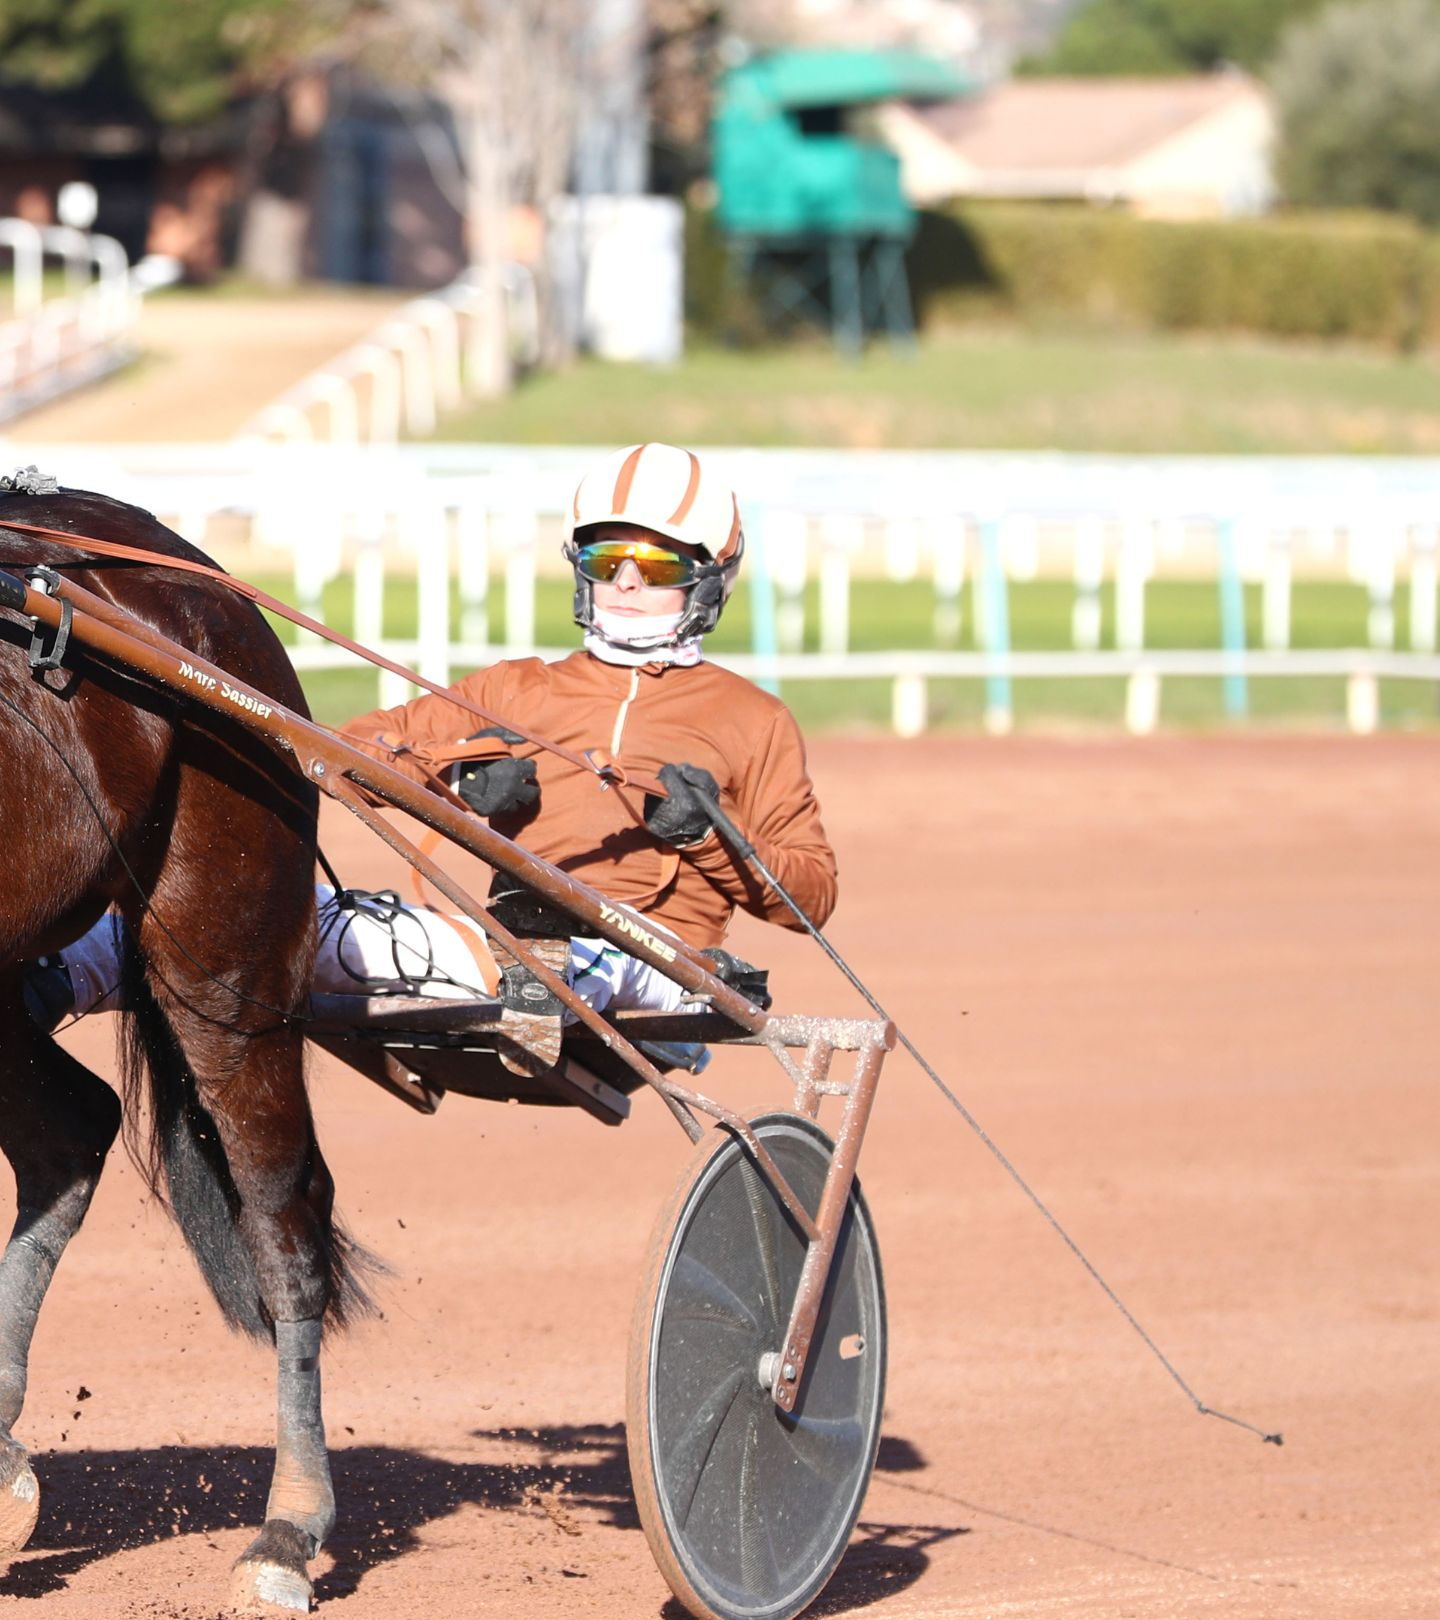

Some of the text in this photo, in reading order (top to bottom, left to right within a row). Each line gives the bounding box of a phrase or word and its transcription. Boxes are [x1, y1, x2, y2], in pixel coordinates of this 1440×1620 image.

[178, 661, 272, 719] Marc Sassier
[599, 902, 677, 963] YANKEE
